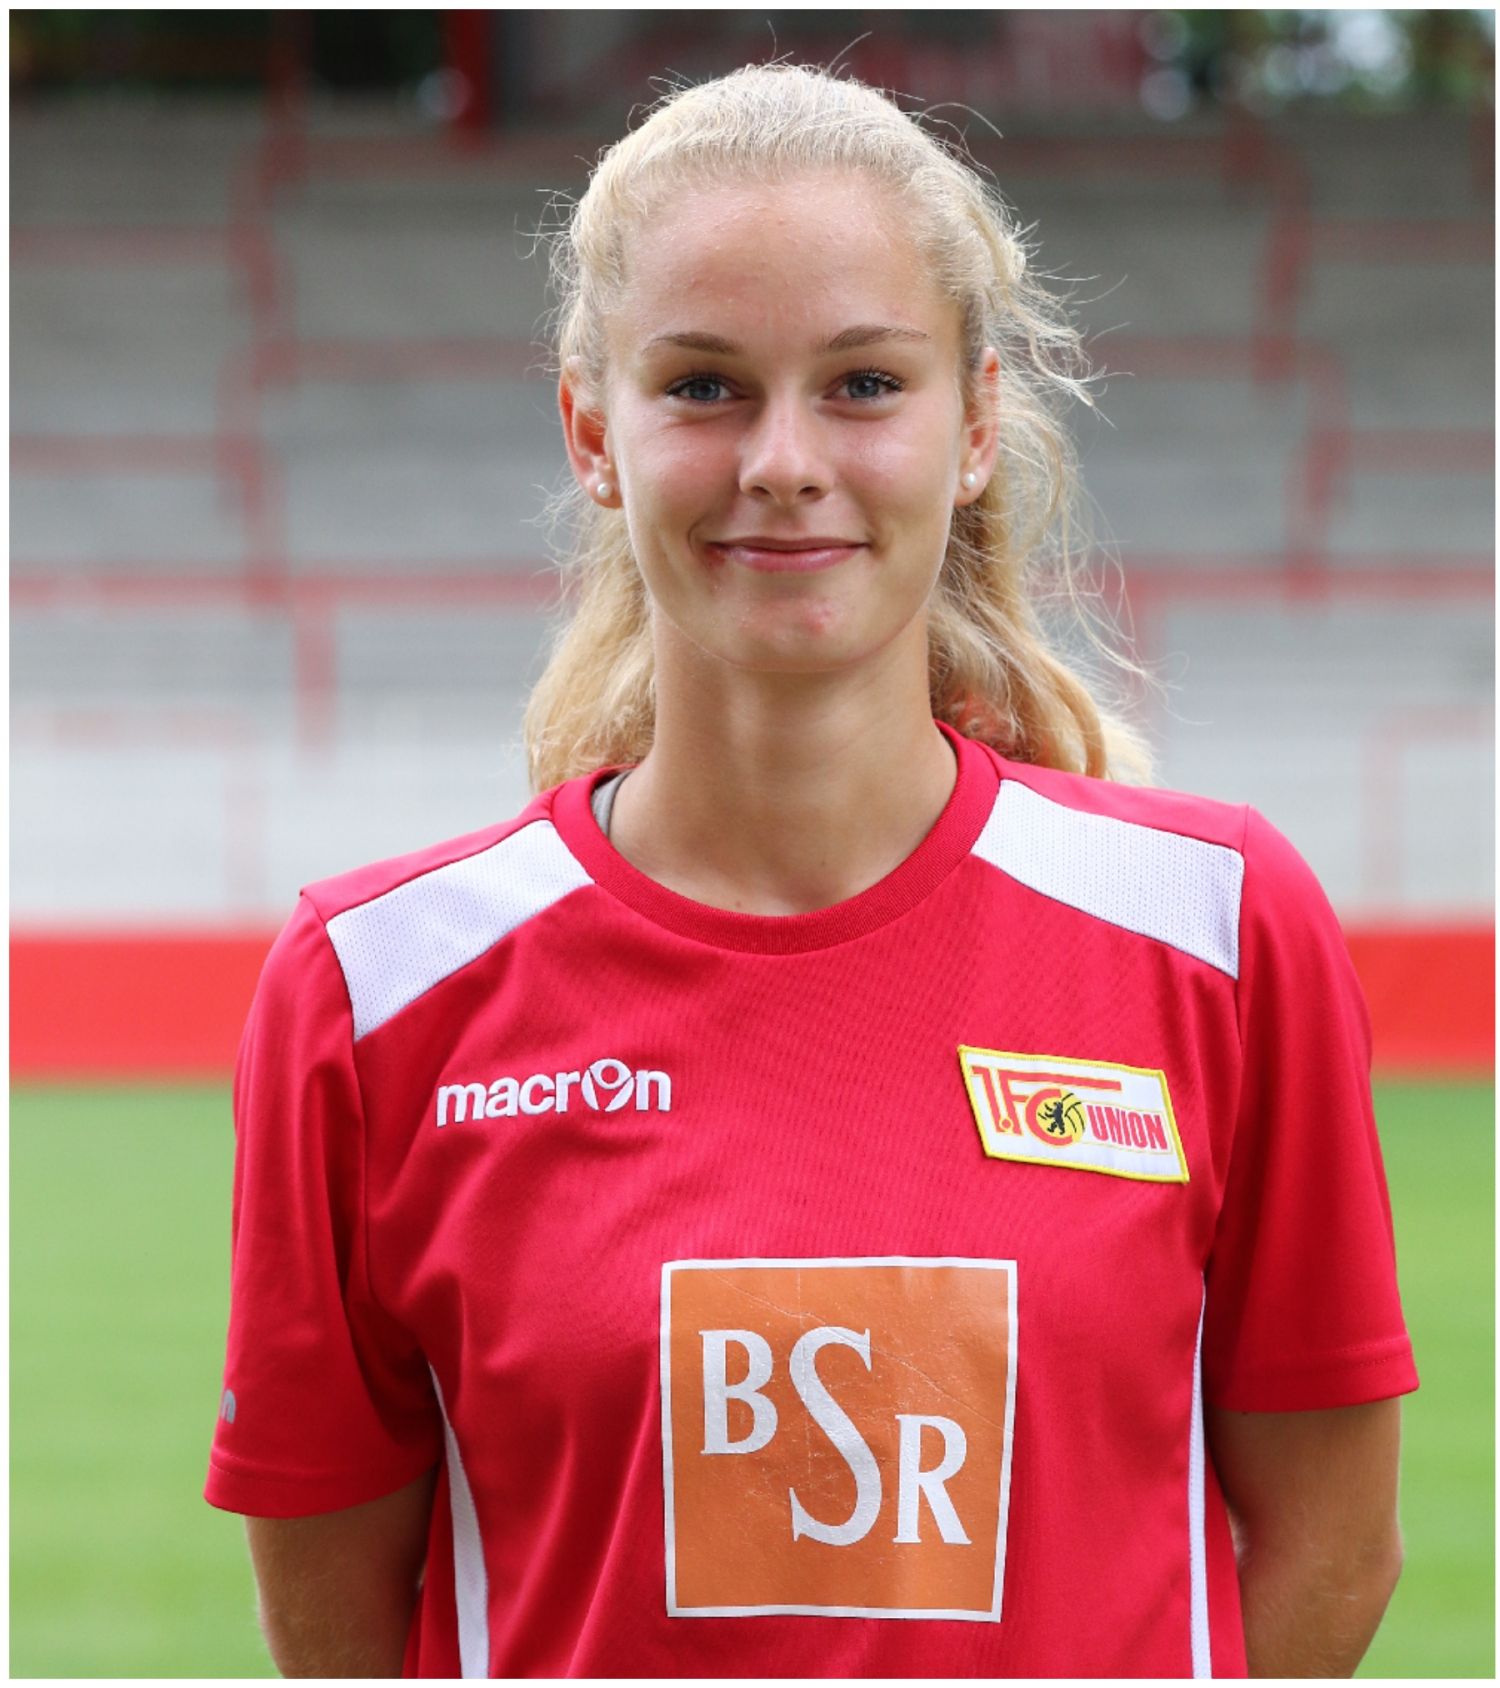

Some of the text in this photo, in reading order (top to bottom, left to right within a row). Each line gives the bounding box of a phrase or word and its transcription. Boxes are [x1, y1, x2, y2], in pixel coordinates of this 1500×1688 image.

[436, 1058, 672, 1127] macron
[1086, 1104, 1169, 1150] UNION
[698, 1326, 972, 1546] BSR
